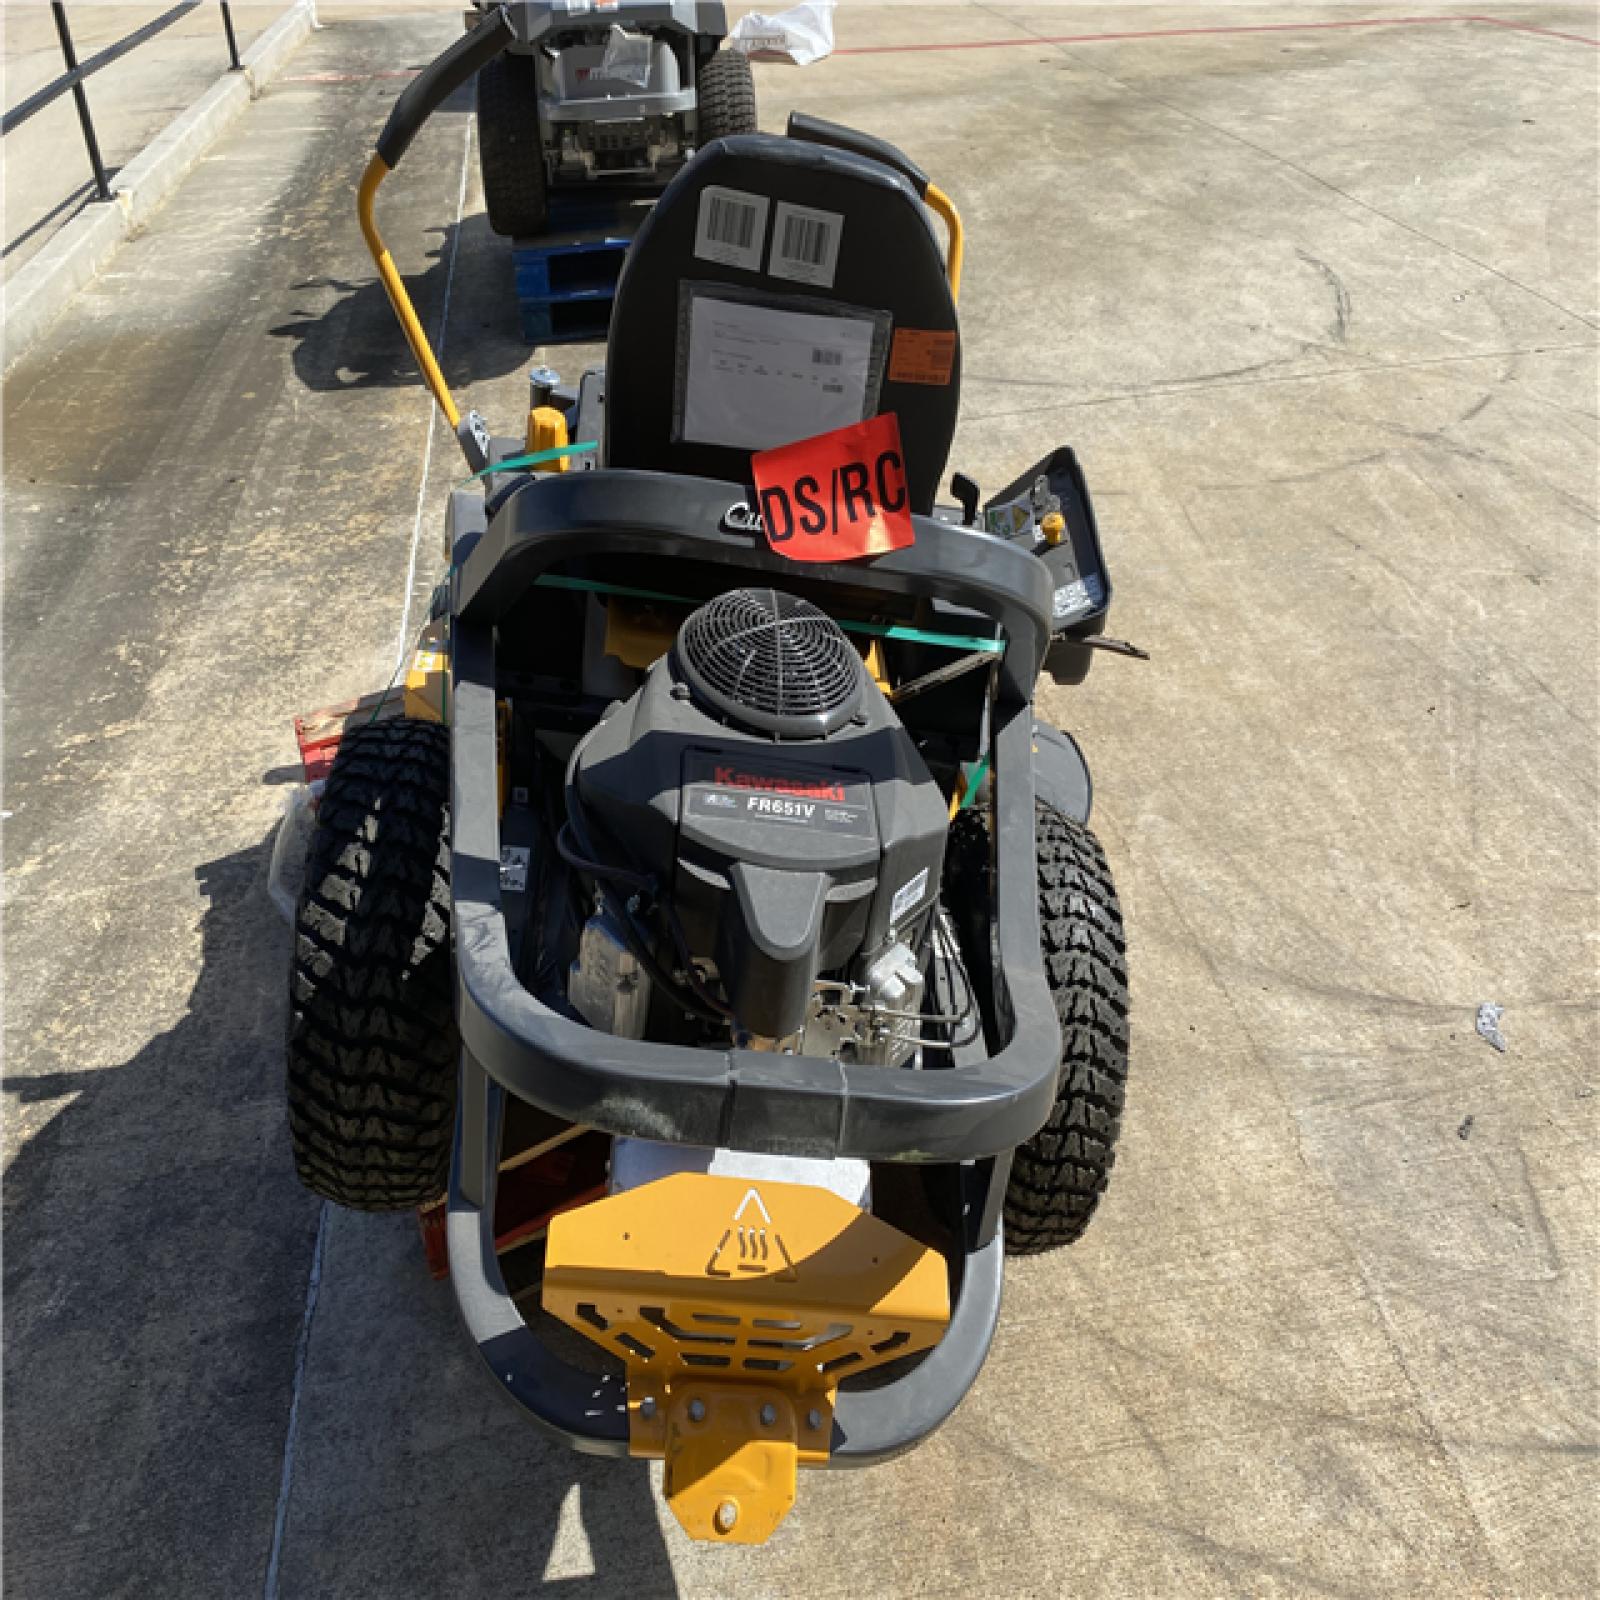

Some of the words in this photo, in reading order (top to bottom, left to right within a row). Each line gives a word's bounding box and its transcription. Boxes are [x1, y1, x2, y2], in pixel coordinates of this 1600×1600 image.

[760, 453, 906, 542] DS/RC
[714, 767, 845, 802] Kawasaki
[747, 797, 815, 818] FR651V
